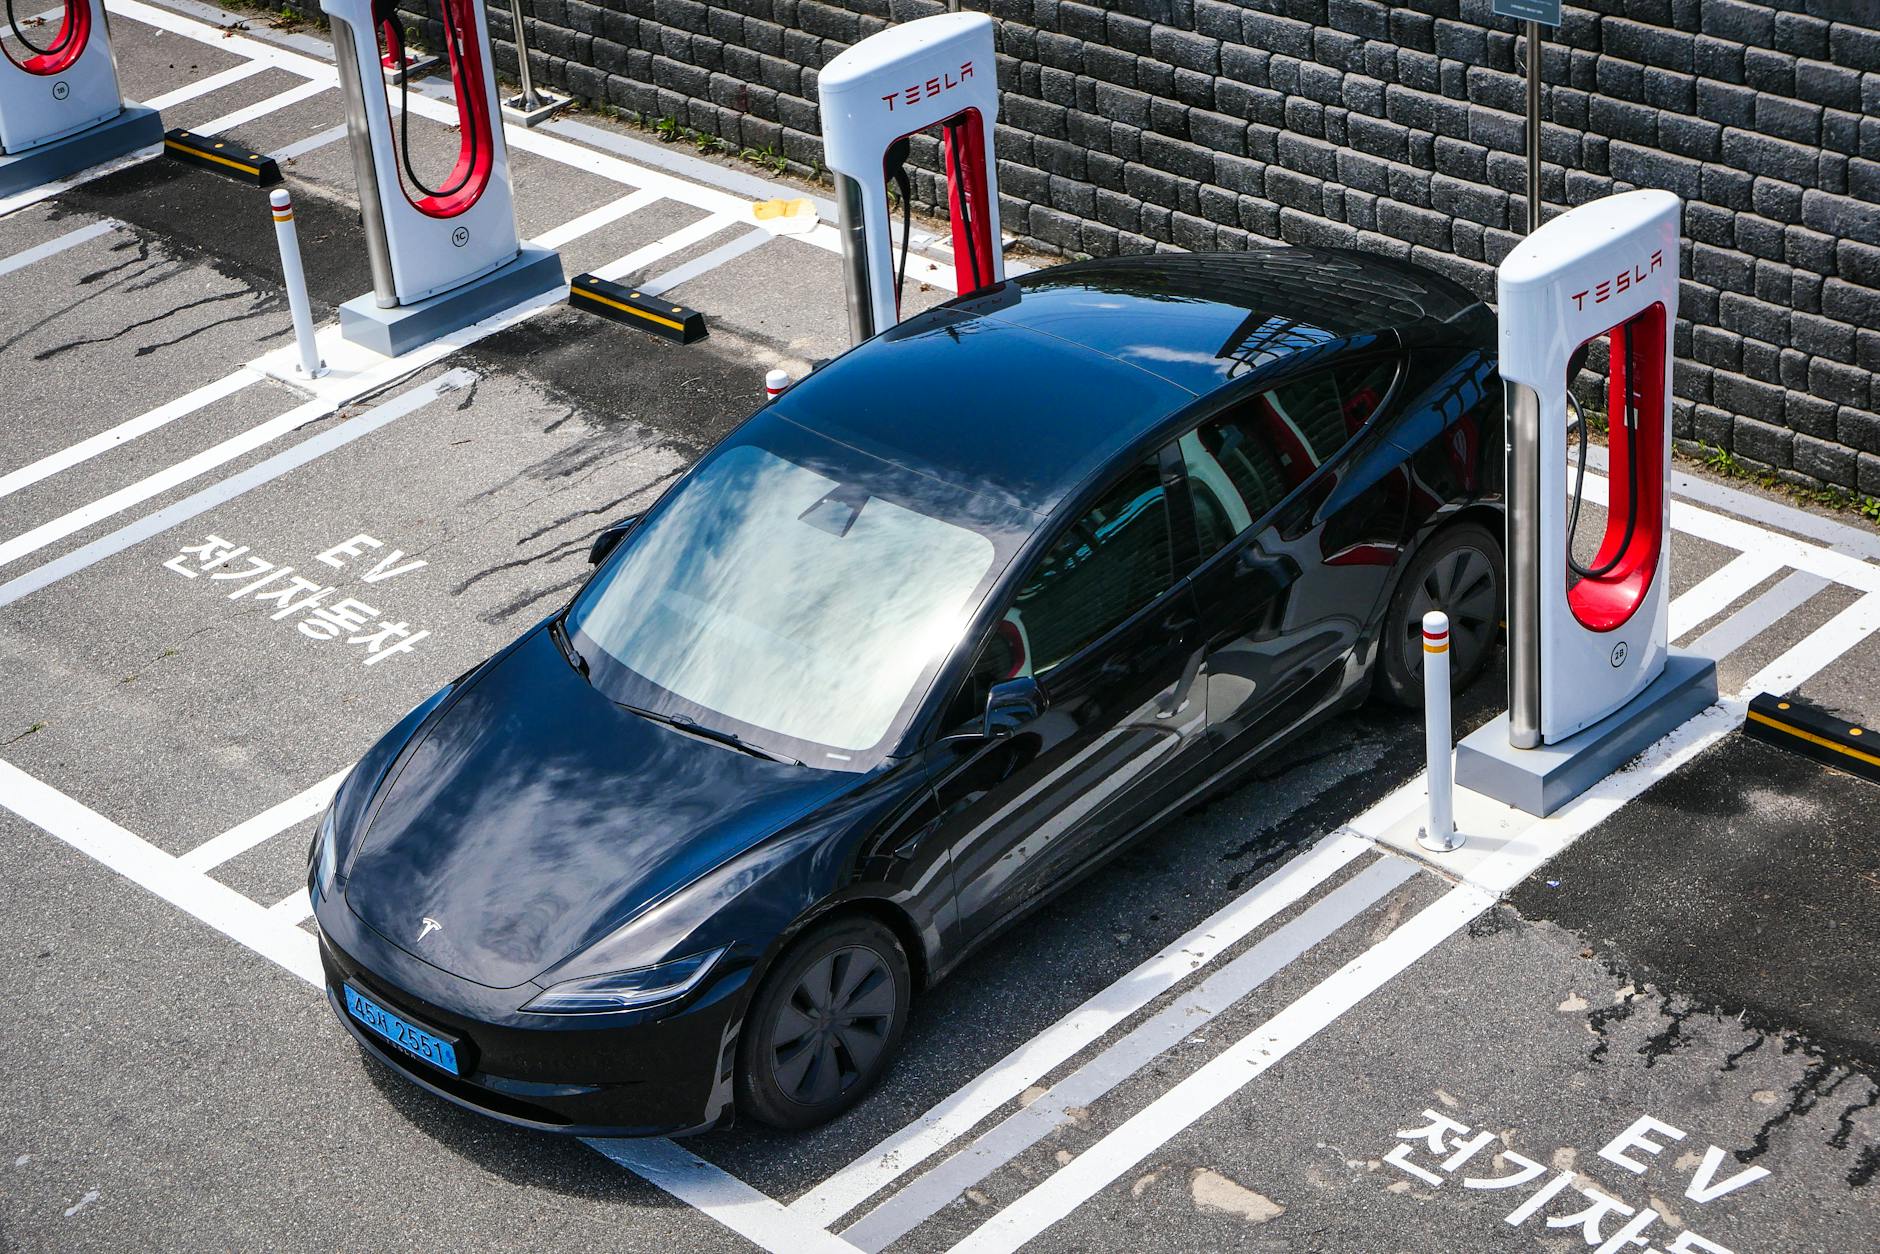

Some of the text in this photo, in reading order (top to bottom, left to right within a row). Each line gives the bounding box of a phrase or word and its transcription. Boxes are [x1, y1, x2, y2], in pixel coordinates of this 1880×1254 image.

[881, 61, 974, 112] TESLA
[1571, 249, 1663, 312] TESLA
[315, 533, 429, 584] EV
[162, 534, 432, 667] 전기자동차
[395, 1021, 443, 1063] 2551
[1597, 1114, 1772, 1204] EV
